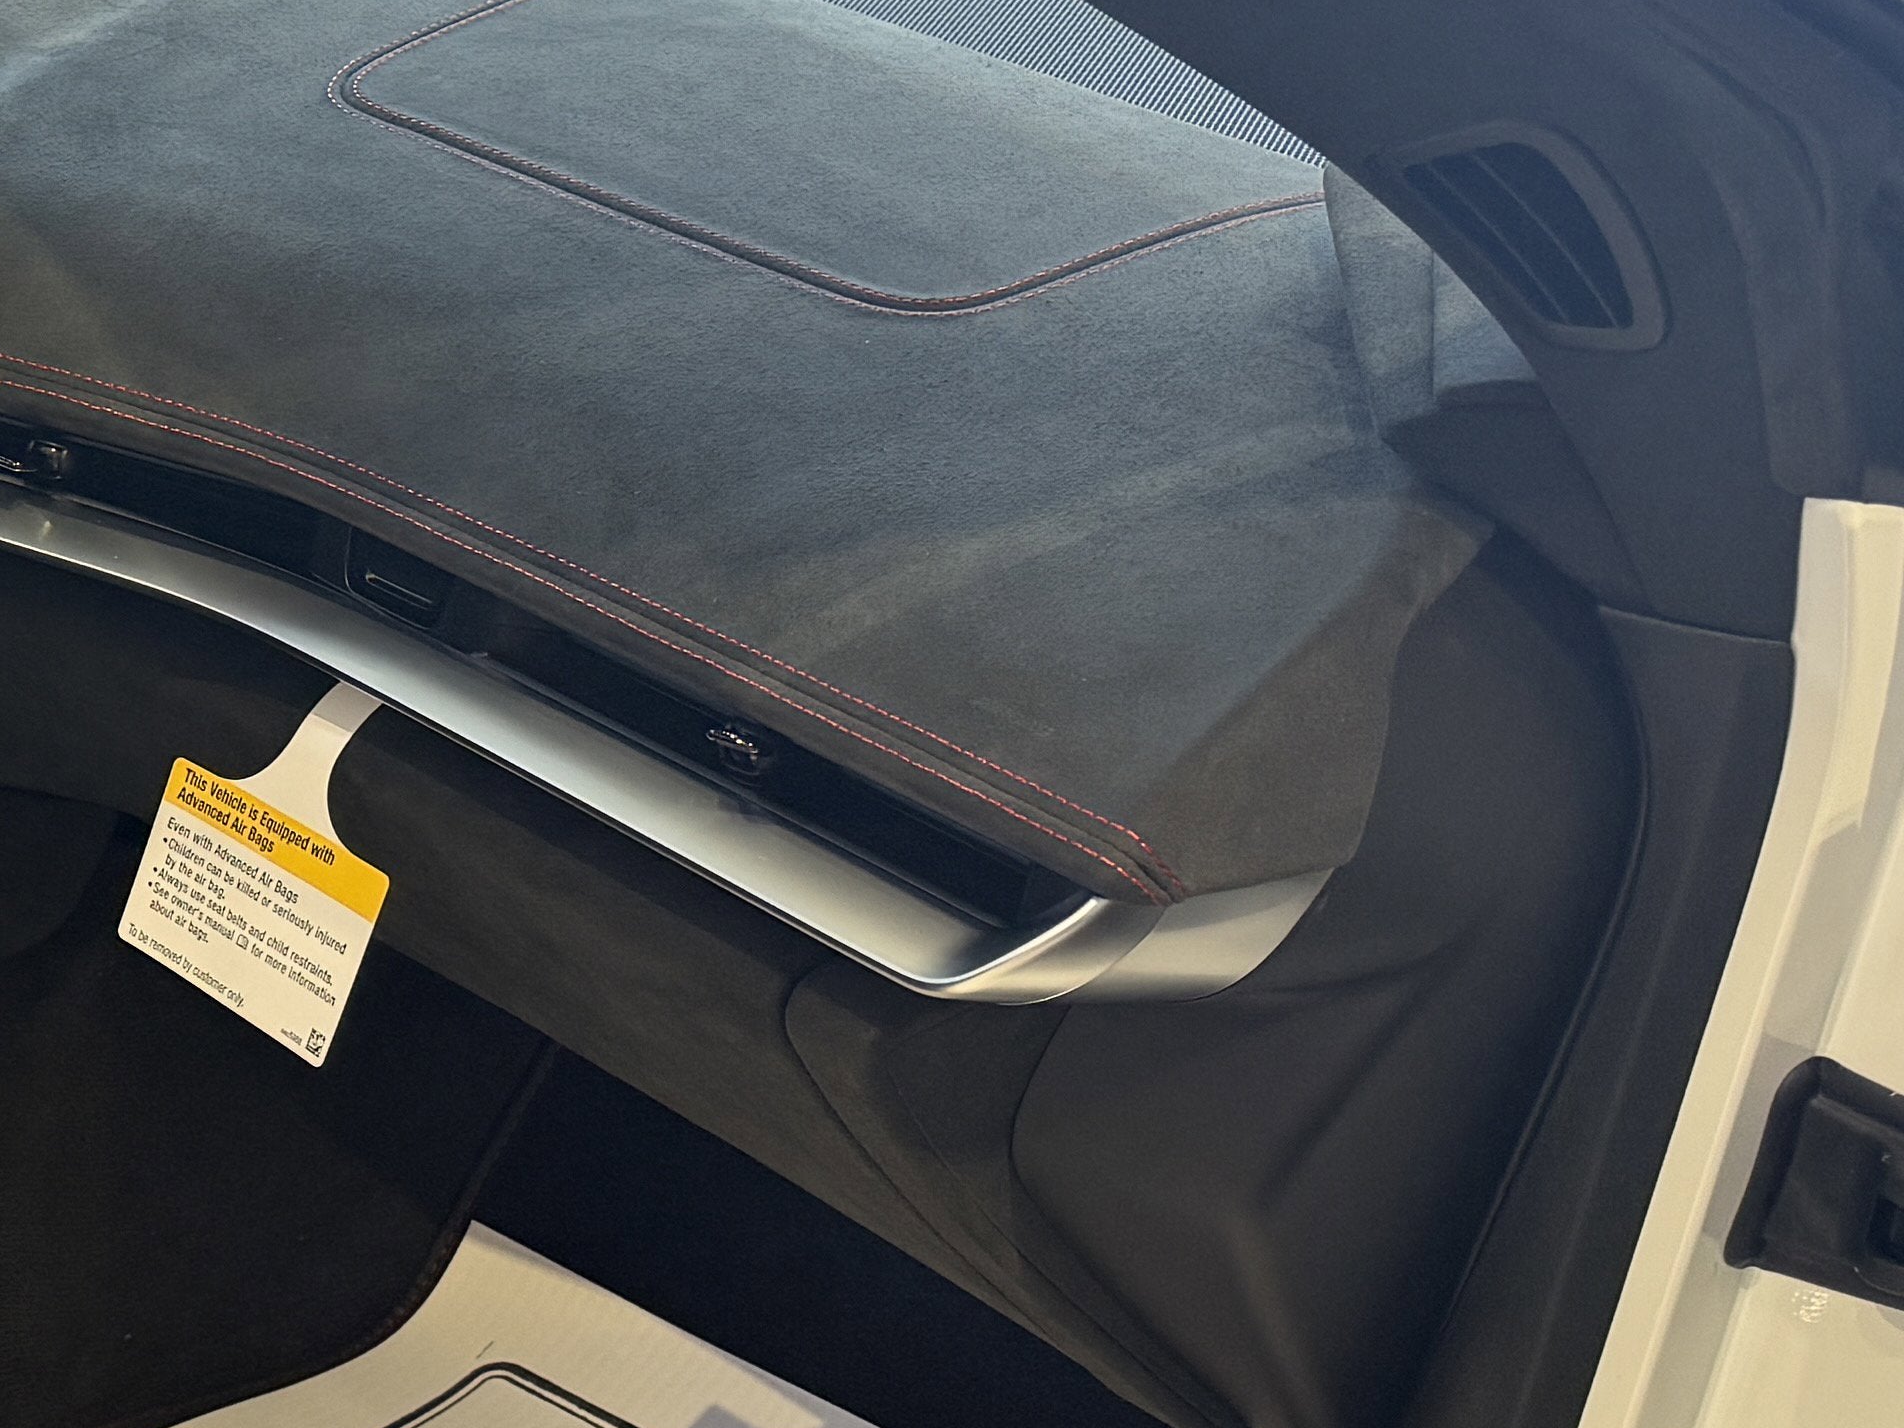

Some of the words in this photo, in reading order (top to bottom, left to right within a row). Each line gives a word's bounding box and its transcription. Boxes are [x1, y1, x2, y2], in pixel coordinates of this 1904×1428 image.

[167, 816, 191, 839] Even
[192, 832, 213, 852] with
[213, 843, 260, 880] Advanced
[257, 871, 274, 888] Air
[273, 879, 299, 904] Bags
[176, 786, 232, 827] Advanced
[229, 816, 248, 836] Air
[247, 825, 275, 853] Bags
[184, 767, 208, 792] This
[210, 780, 247, 815] Vehicle
[247, 803, 259, 822] is
[259, 810, 311, 852] Equipped
[310, 842, 335, 866] with
